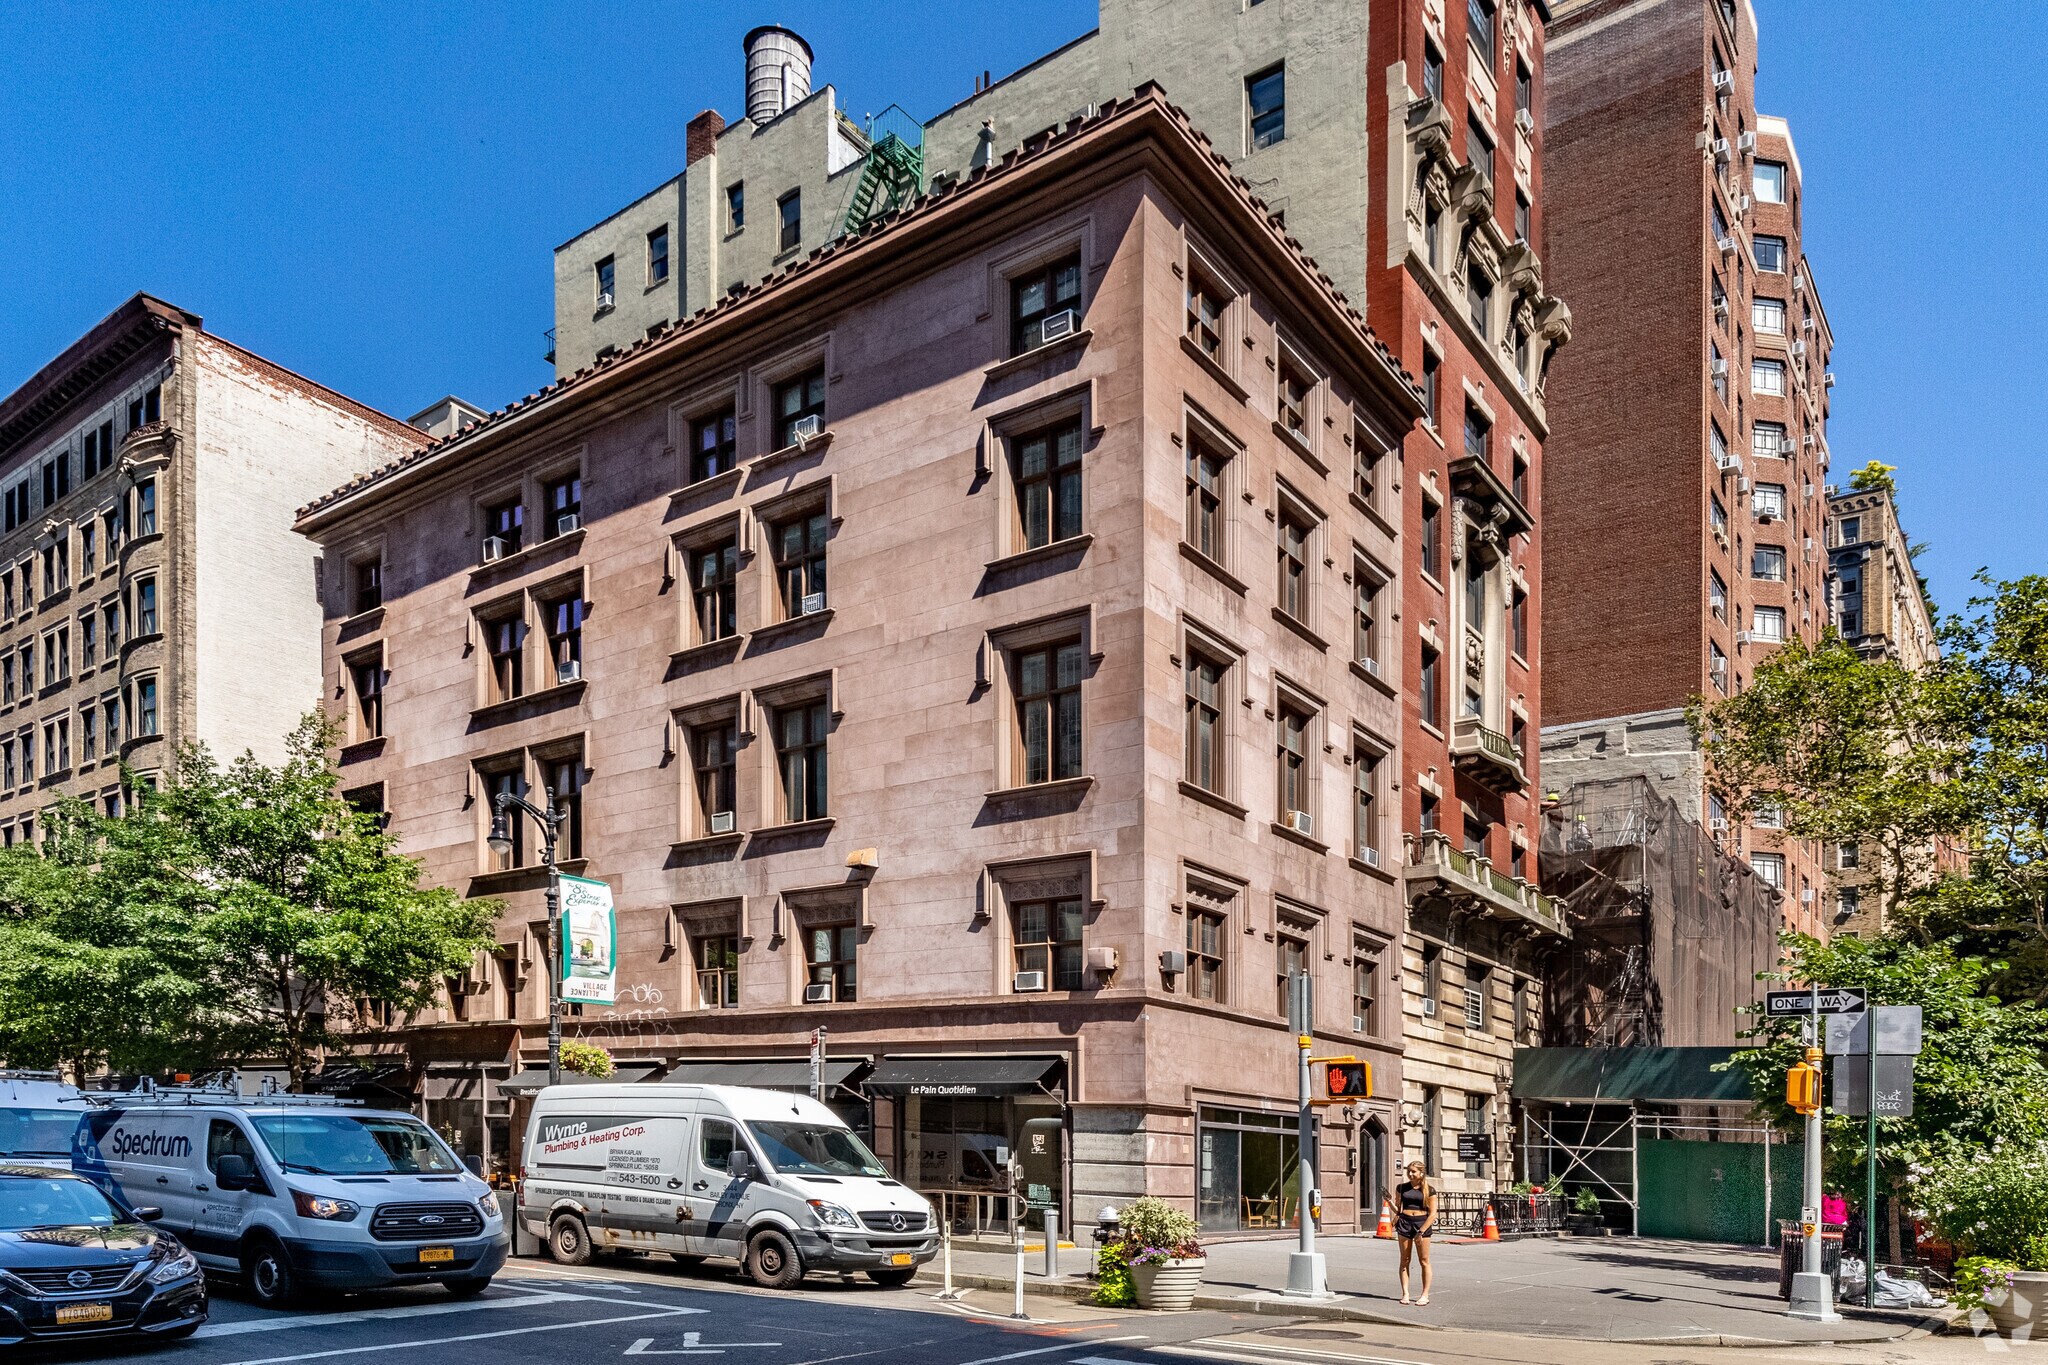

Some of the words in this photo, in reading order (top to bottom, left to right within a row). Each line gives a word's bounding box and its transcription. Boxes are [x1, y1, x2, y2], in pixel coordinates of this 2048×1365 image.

[570, 987, 600, 997] ALLIANCE
[582, 982, 608, 991] VILLAGE
[1775, 998, 1804, 1009] ONE
[1820, 995, 1852, 1007] WAY
[910, 1085, 920, 1094] Le
[920, 1085, 937, 1094] Pain
[938, 1085, 977, 1094] Quotidien
[545, 1121, 587, 1142] Wynne
[112, 1127, 190, 1161] Spectrum
[544, 1139, 579, 1155] Plumbing
[580, 1136, 587, 1147] &
[589, 1130, 621, 1145] Heating
[622, 1125, 646, 1137] Corp.
[618, 1173, 661, 1186] 543-1500
[207, 1204, 242, 1213] spectrum.com
